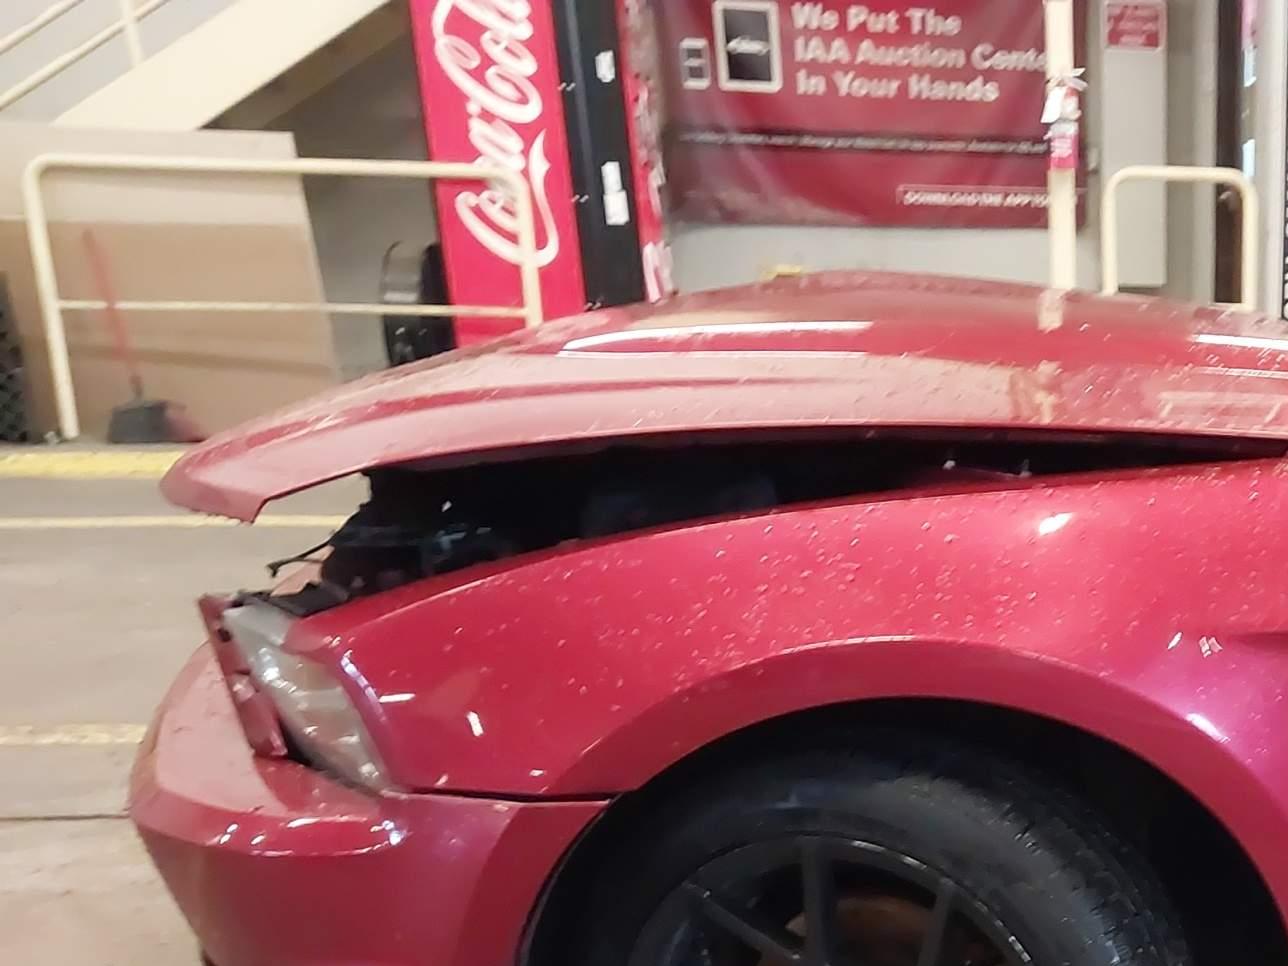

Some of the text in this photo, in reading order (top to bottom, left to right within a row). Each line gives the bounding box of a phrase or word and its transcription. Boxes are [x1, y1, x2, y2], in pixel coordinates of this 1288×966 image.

[791, 3, 962, 36] We Put The
[795, 36, 851, 64] IAA
[855, 38, 966, 68] Auction
[796, 70, 999, 102] In Your Hands
[431, 0, 559, 268] Coa-Col
